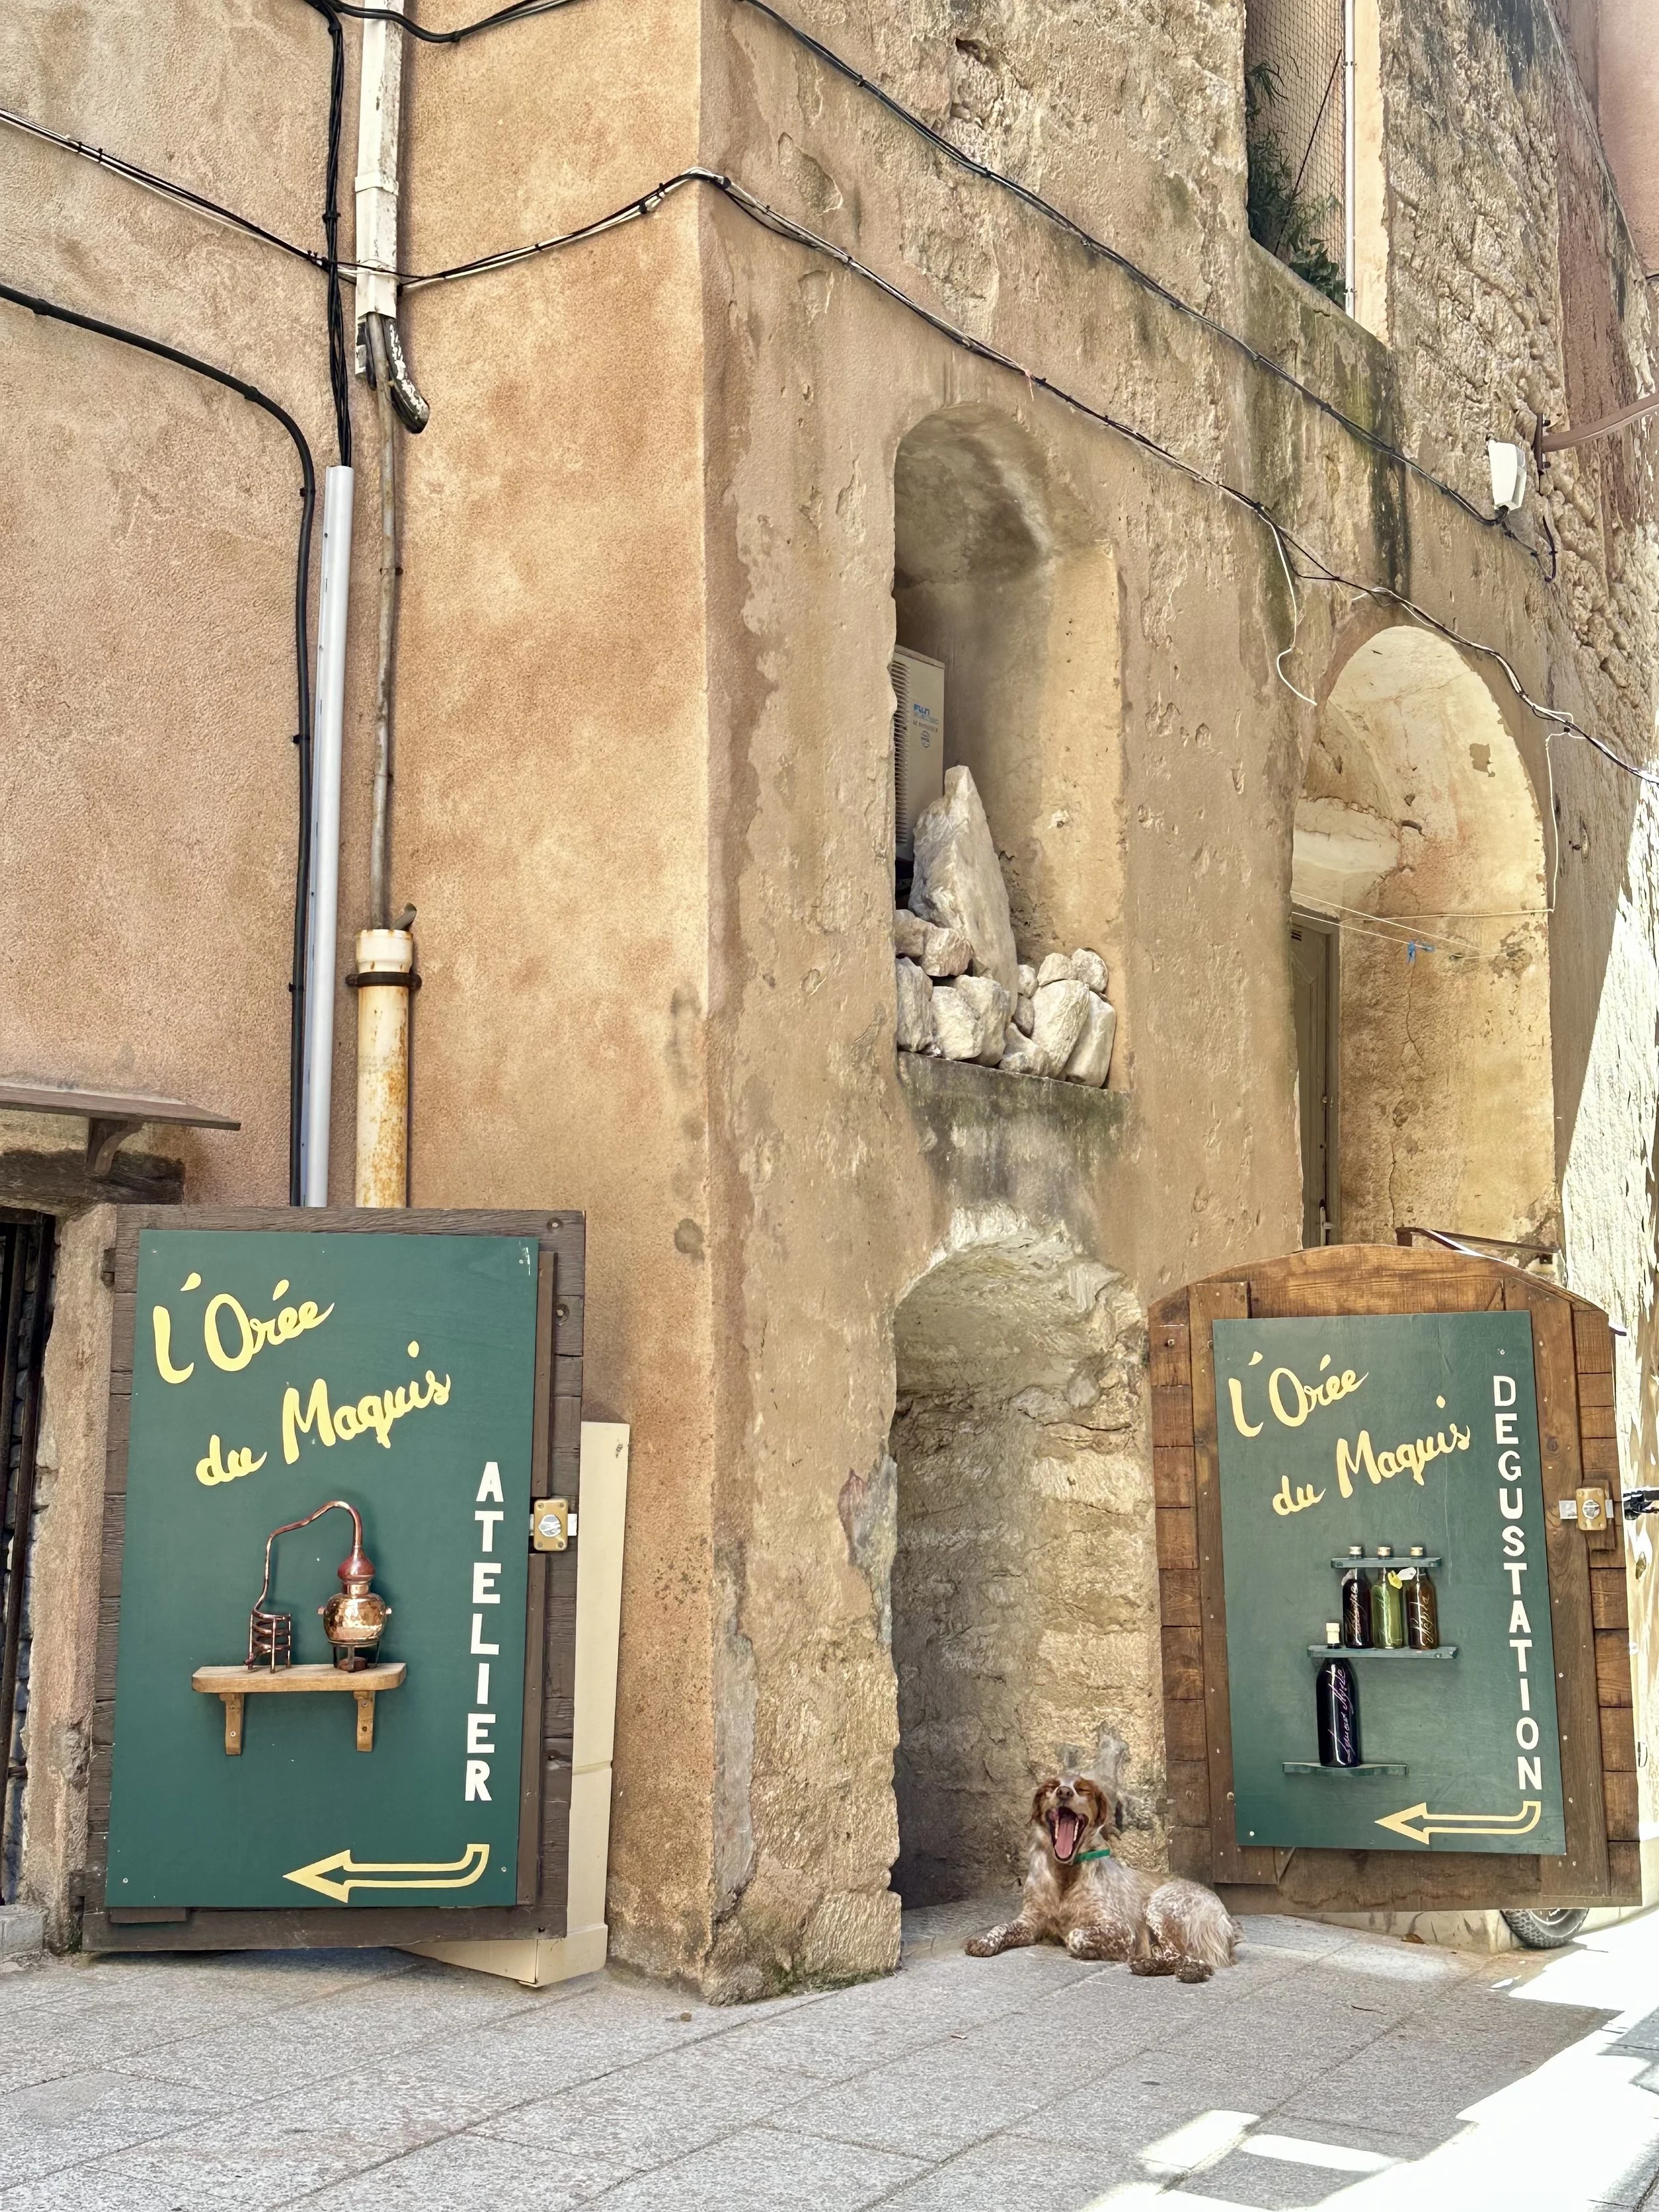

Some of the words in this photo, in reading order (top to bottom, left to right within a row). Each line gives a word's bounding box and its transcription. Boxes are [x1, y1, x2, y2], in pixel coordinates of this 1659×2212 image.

[195, 1434, 267, 1486] du
[282, 1340, 451, 1465] Maquis
[1271, 1475, 1327, 1516] du
[1336, 1395, 1471, 1499] Maquis
[465, 1461, 504, 1801] ATELIER
[1492, 1375, 1543, 1791] DEGUSTATION
